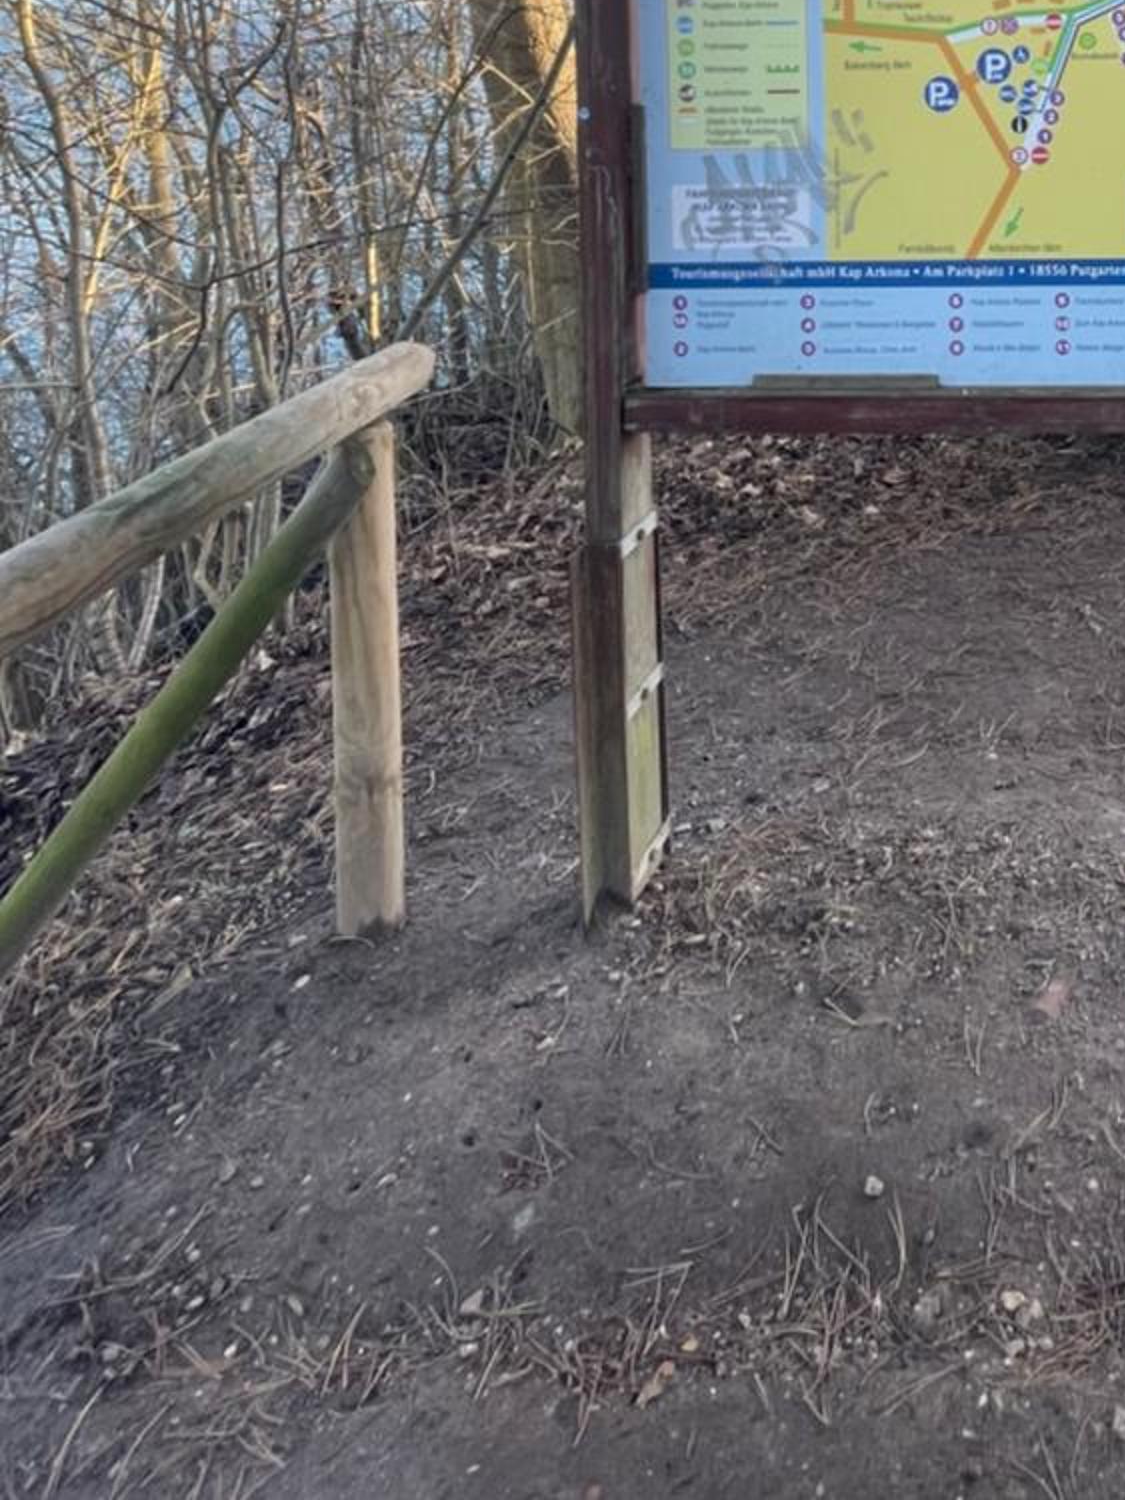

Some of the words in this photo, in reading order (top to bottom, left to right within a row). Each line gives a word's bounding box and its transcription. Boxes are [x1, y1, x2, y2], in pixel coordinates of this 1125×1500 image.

[838, 266, 862, 282] Kap
[865, 265, 910, 279] Arkona
[924, 265, 945, 278] Am
[947, 263, 1001, 280] Parkplatz
